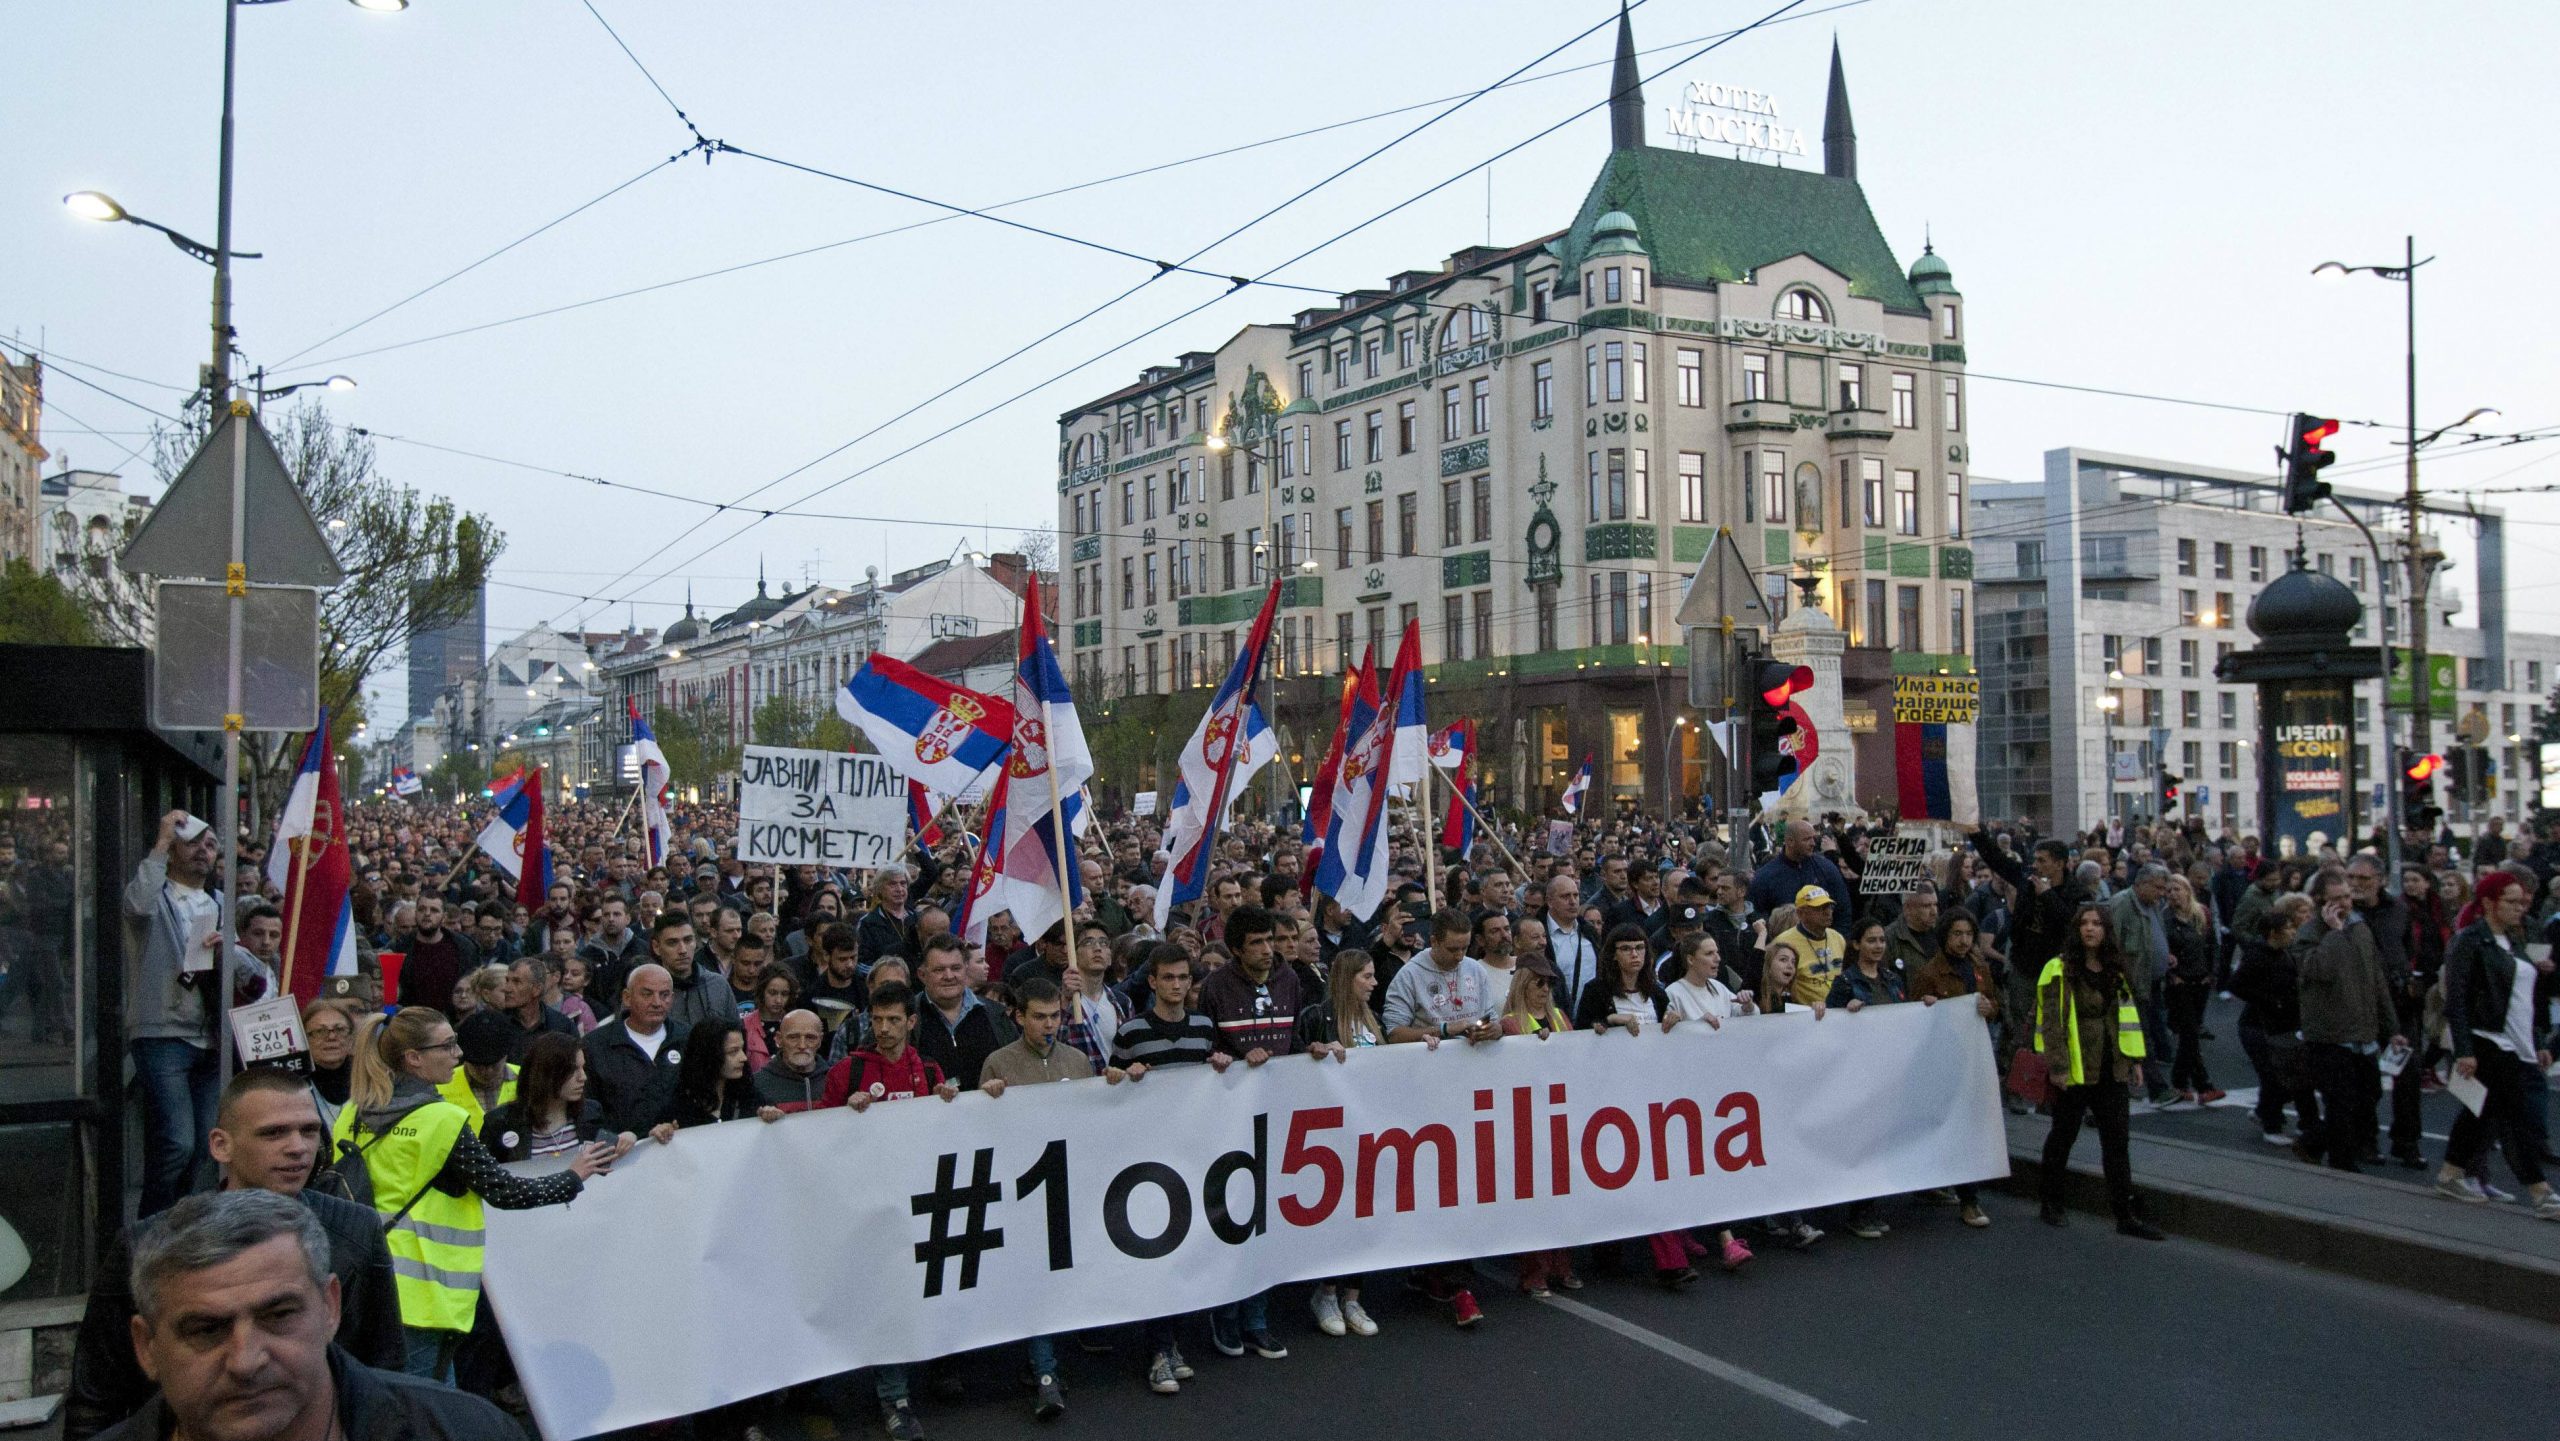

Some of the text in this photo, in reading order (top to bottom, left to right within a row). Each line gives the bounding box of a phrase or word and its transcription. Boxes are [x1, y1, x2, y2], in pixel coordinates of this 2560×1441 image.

[1690, 80, 1778, 117] ХОТЕЛ
[1666, 106, 1807, 156] МОСКВА
[1894, 676, 1978, 694] Има нас
[2276, 724, 2347, 742] LIBERTY
[743, 755, 821, 794] ЈАВНИ
[838, 758, 905, 798] ПЛАН
[791, 794, 837, 820] ЗА
[749, 824, 893, 865] КОСМЕТ?!
[1869, 837, 1926, 856] СРБИЈА
[253, 1030, 279, 1045] SVI
[911, 1082, 1768, 1300] #1od5miliona
